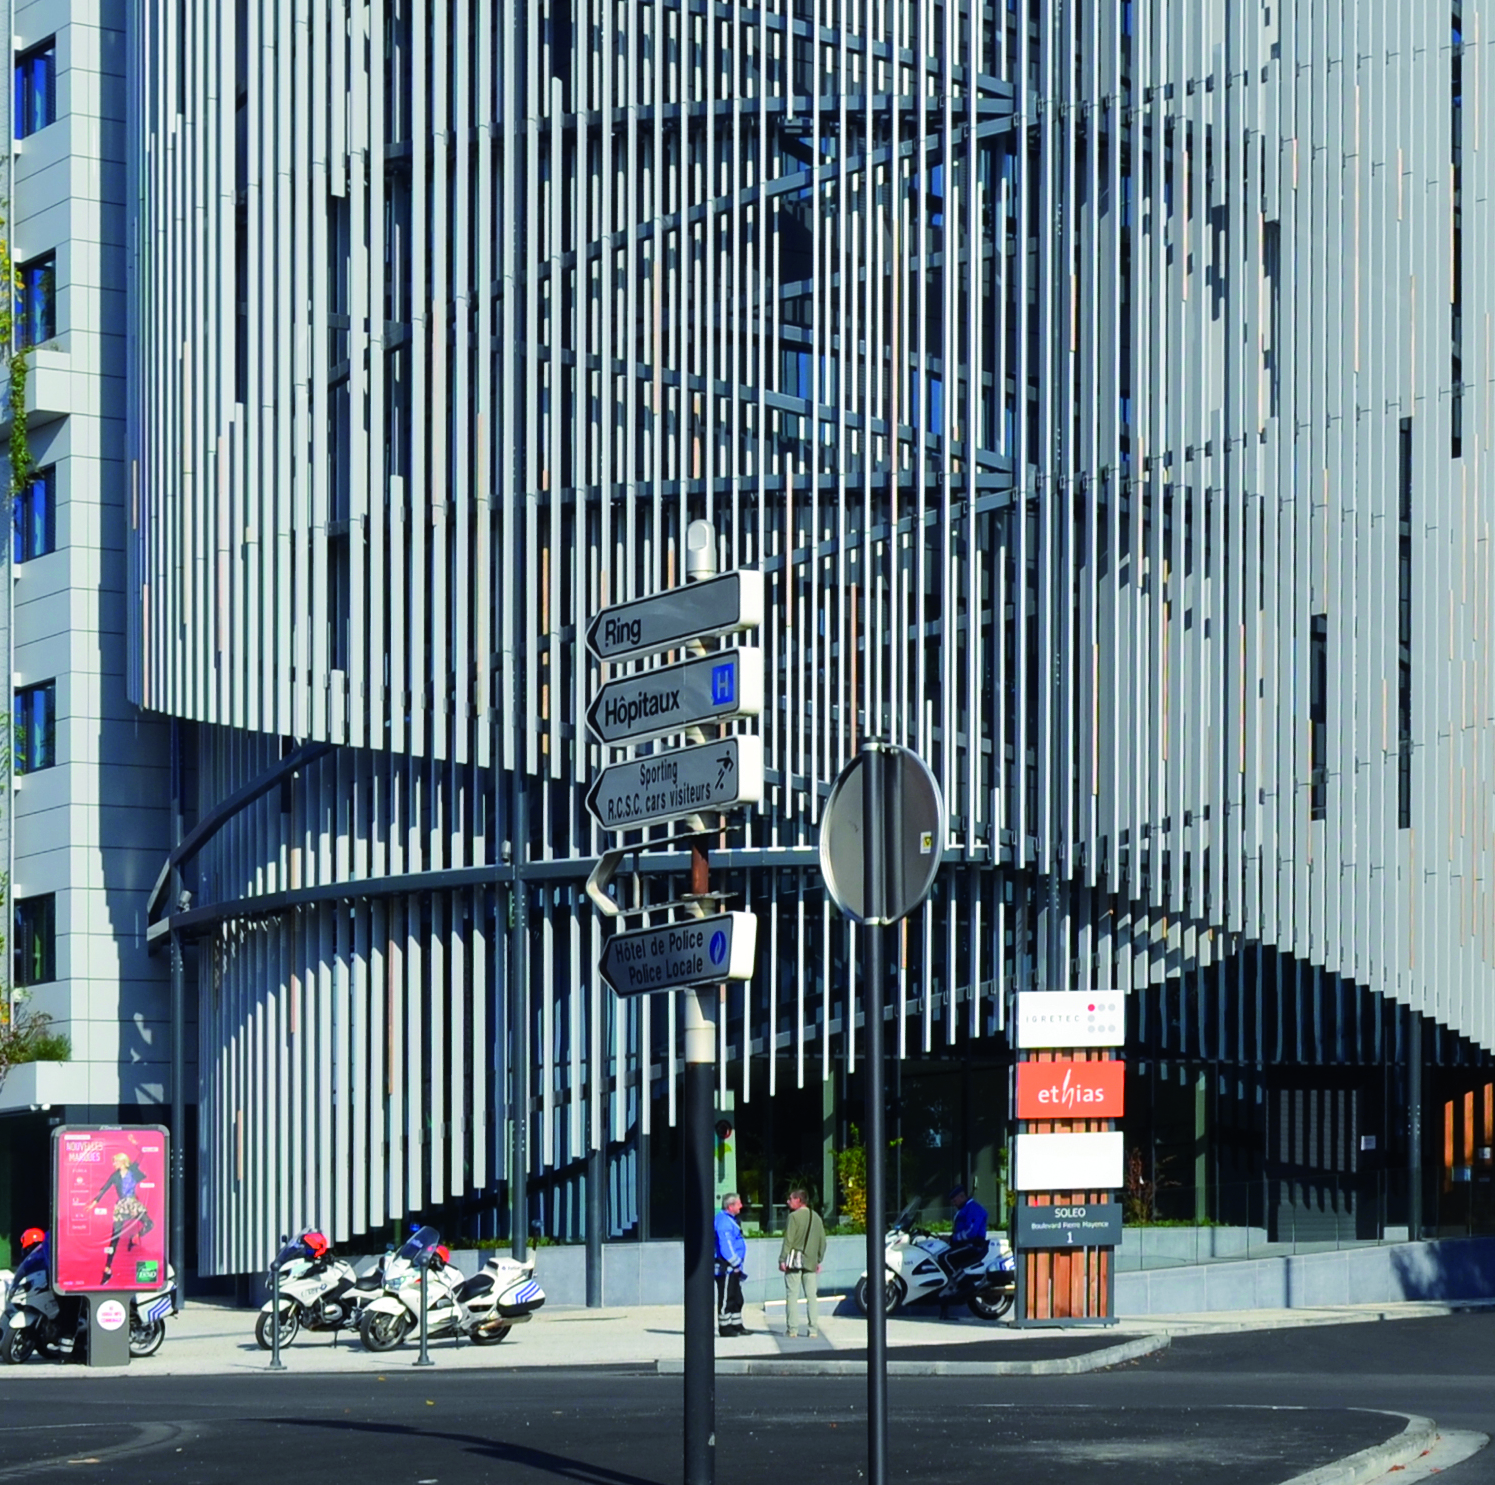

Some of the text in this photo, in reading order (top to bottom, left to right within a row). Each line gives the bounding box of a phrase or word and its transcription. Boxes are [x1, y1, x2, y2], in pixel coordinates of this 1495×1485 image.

[605, 618, 641, 647] Ring
[605, 690, 680, 728] Hôpitaux
[639, 759, 678, 790] Sporting
[607, 783, 711, 820] R.C.S.C. cars visiteurs
[615, 929, 703, 963] Hôtel de Police
[628, 954, 703, 986] Police Locale
[1026, 1015, 1080, 1023] IGRETEC
[1037, 1068, 1104, 1110] ethias
[1031, 1220, 1109, 1230] Boulevard Pierre Mayence
[1054, 1207, 1087, 1218] SOLEO
[1066, 1231, 1074, 1244] 1
